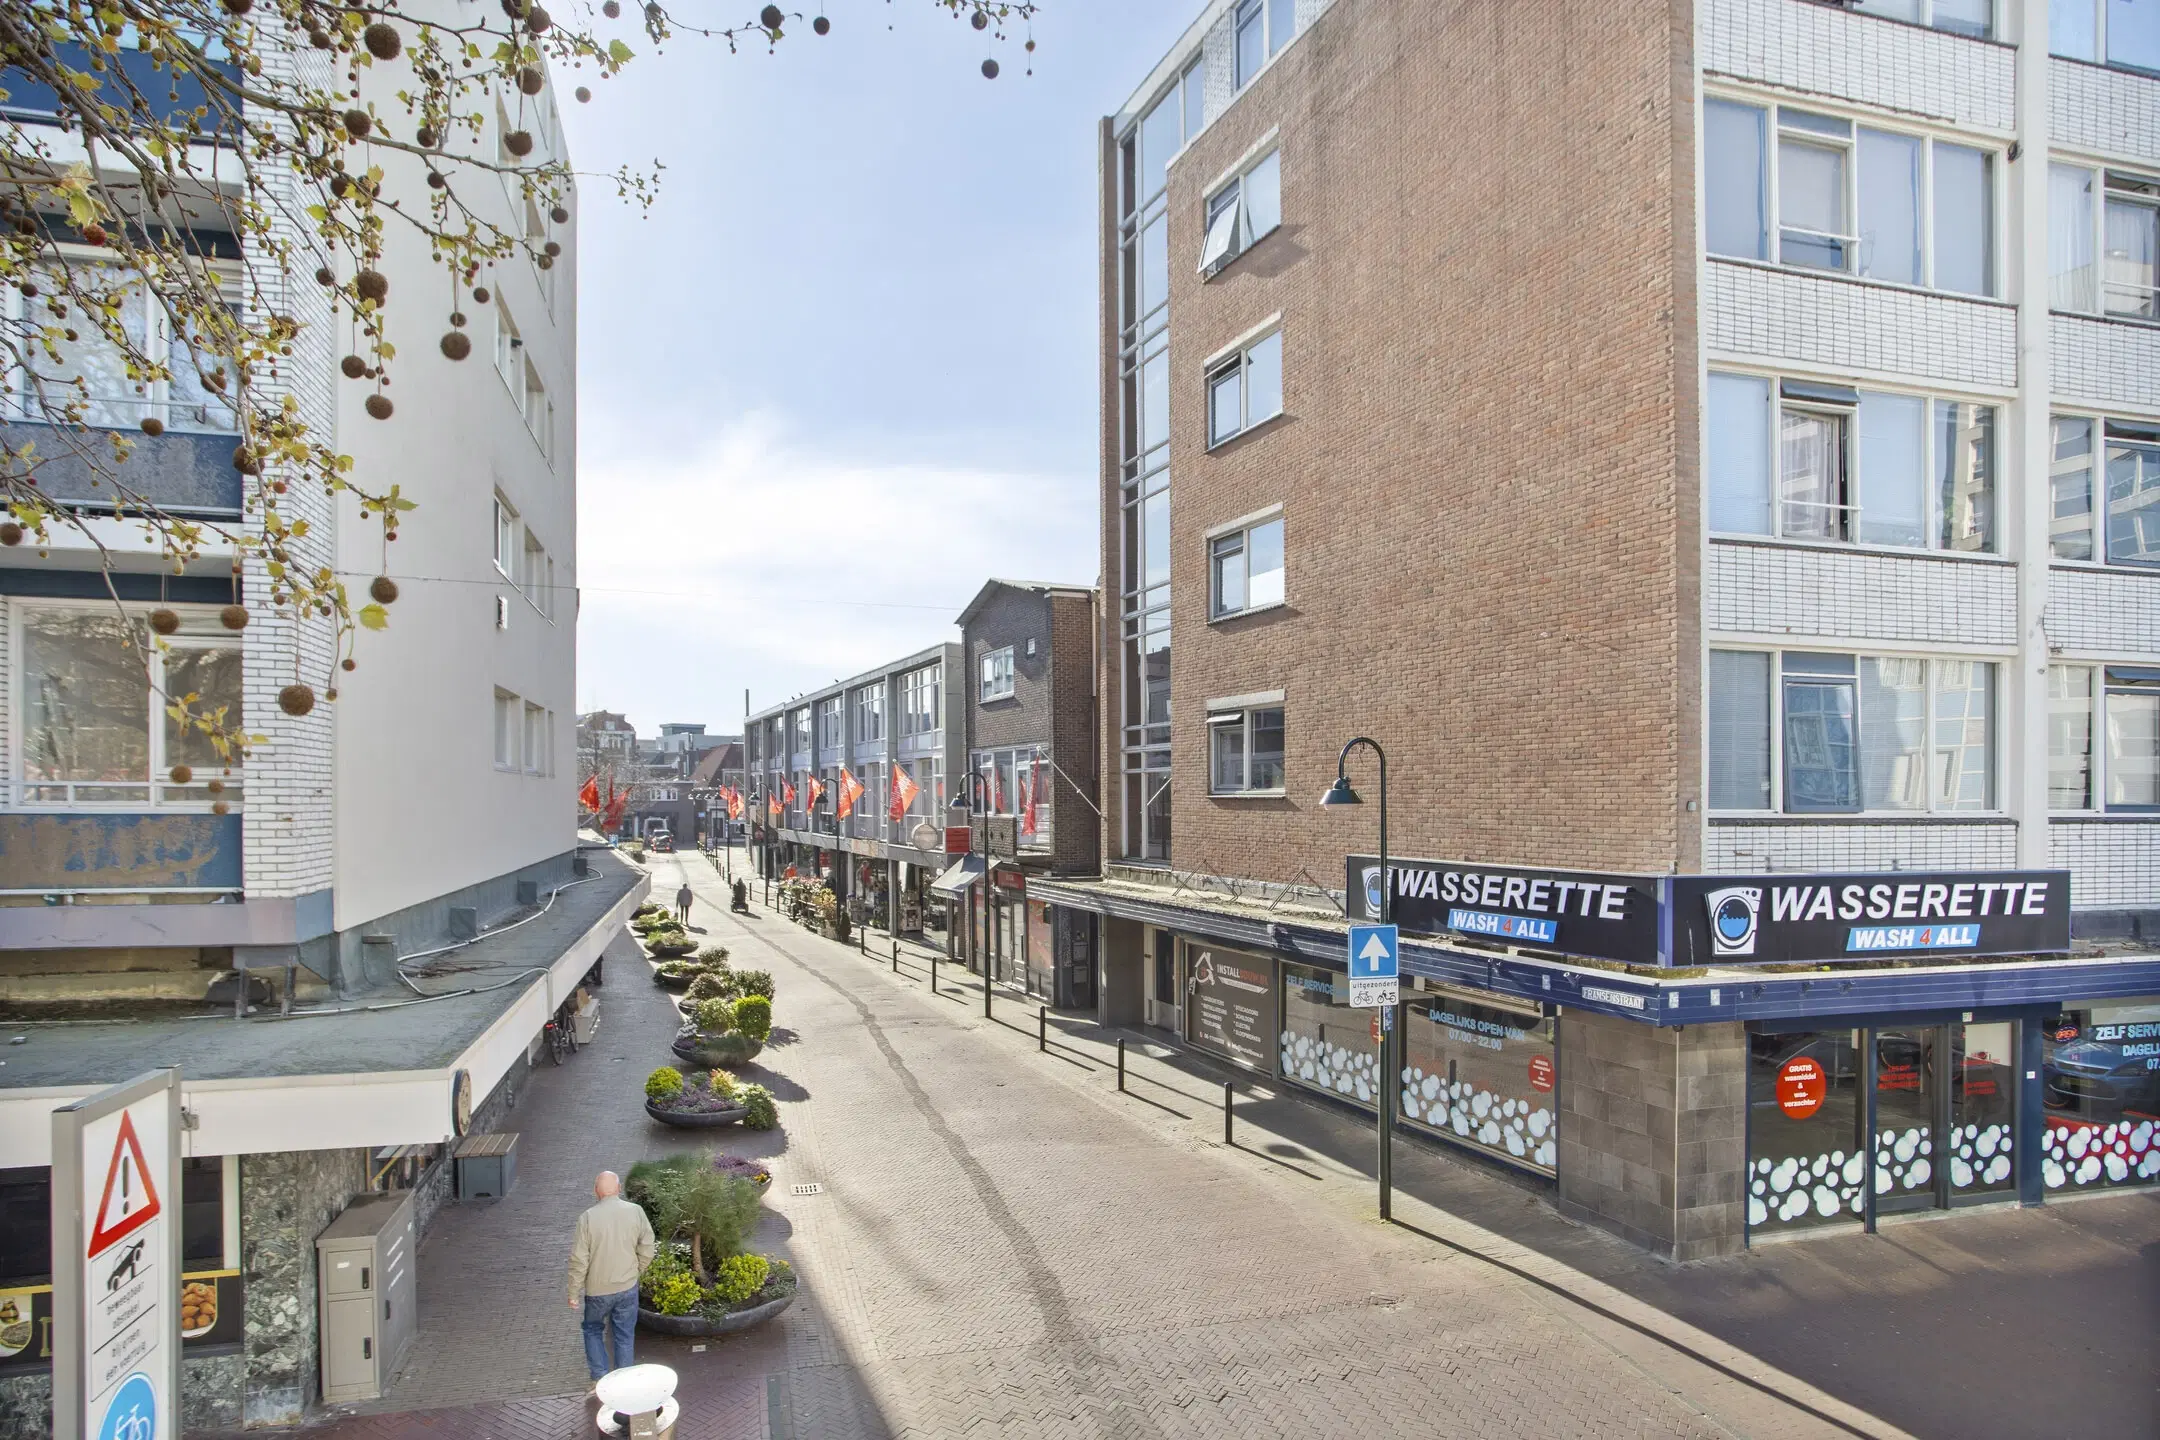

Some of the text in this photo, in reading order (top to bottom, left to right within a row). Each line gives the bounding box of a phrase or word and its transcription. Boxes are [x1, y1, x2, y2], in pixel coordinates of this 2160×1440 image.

[1398, 868, 1628, 920] WASSERETTE
[1771, 882, 2048, 921] WASSERETTE
[1453, 911, 1549, 939] WASH 4 ALL
[1855, 927, 1973, 948] WASH 4 ALL
[1352, 981, 1397, 989] uitgezonderd
[1429, 1009, 1525, 1041] DAGELIJKS OPEN VAN
[2095, 1025, 2126, 1040] ZELF
[1449, 1028, 1472, 1043] 07.00
[1478, 1036, 1502, 1051] 22.00
[1789, 1064, 1812, 1072] GRATIS
